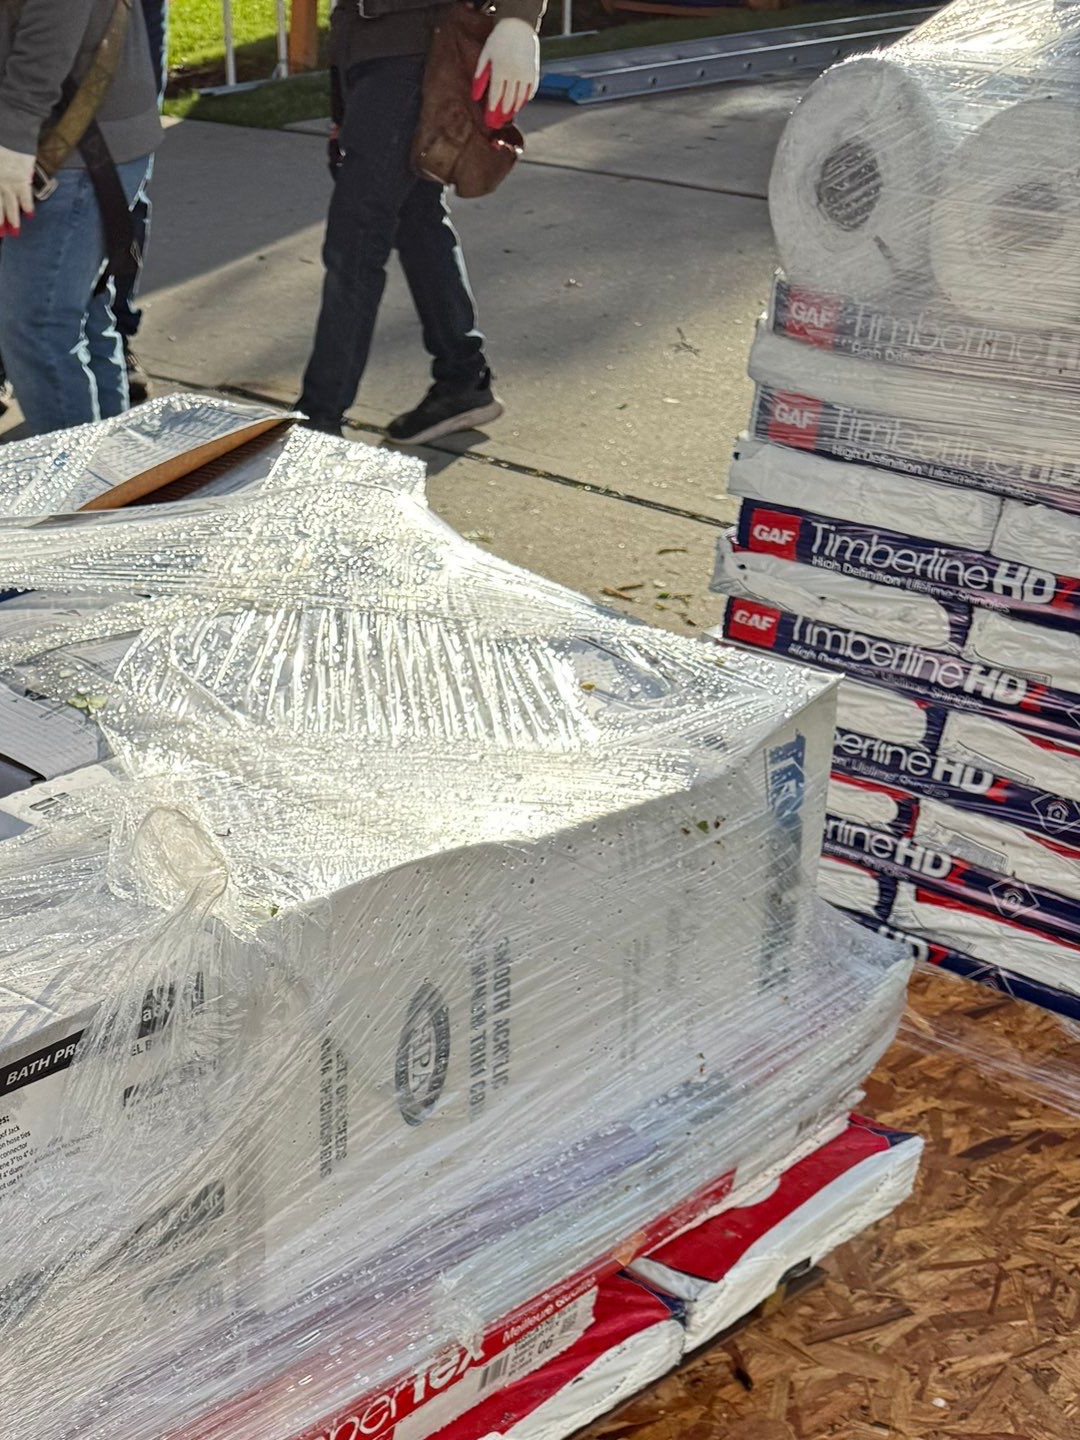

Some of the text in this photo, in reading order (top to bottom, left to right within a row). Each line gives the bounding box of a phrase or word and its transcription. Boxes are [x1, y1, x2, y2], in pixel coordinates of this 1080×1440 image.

[790, 301, 830, 328] GAF
[774, 401, 816, 429] GAF
[752, 523, 797, 545] GAF
[732, 609, 776, 632] GAF
[492, 936, 512, 1090] SMOOTH ACRYLIC
[5, 1054, 52, 1086] BATH
[0, 1142, 29, 1160] connector
